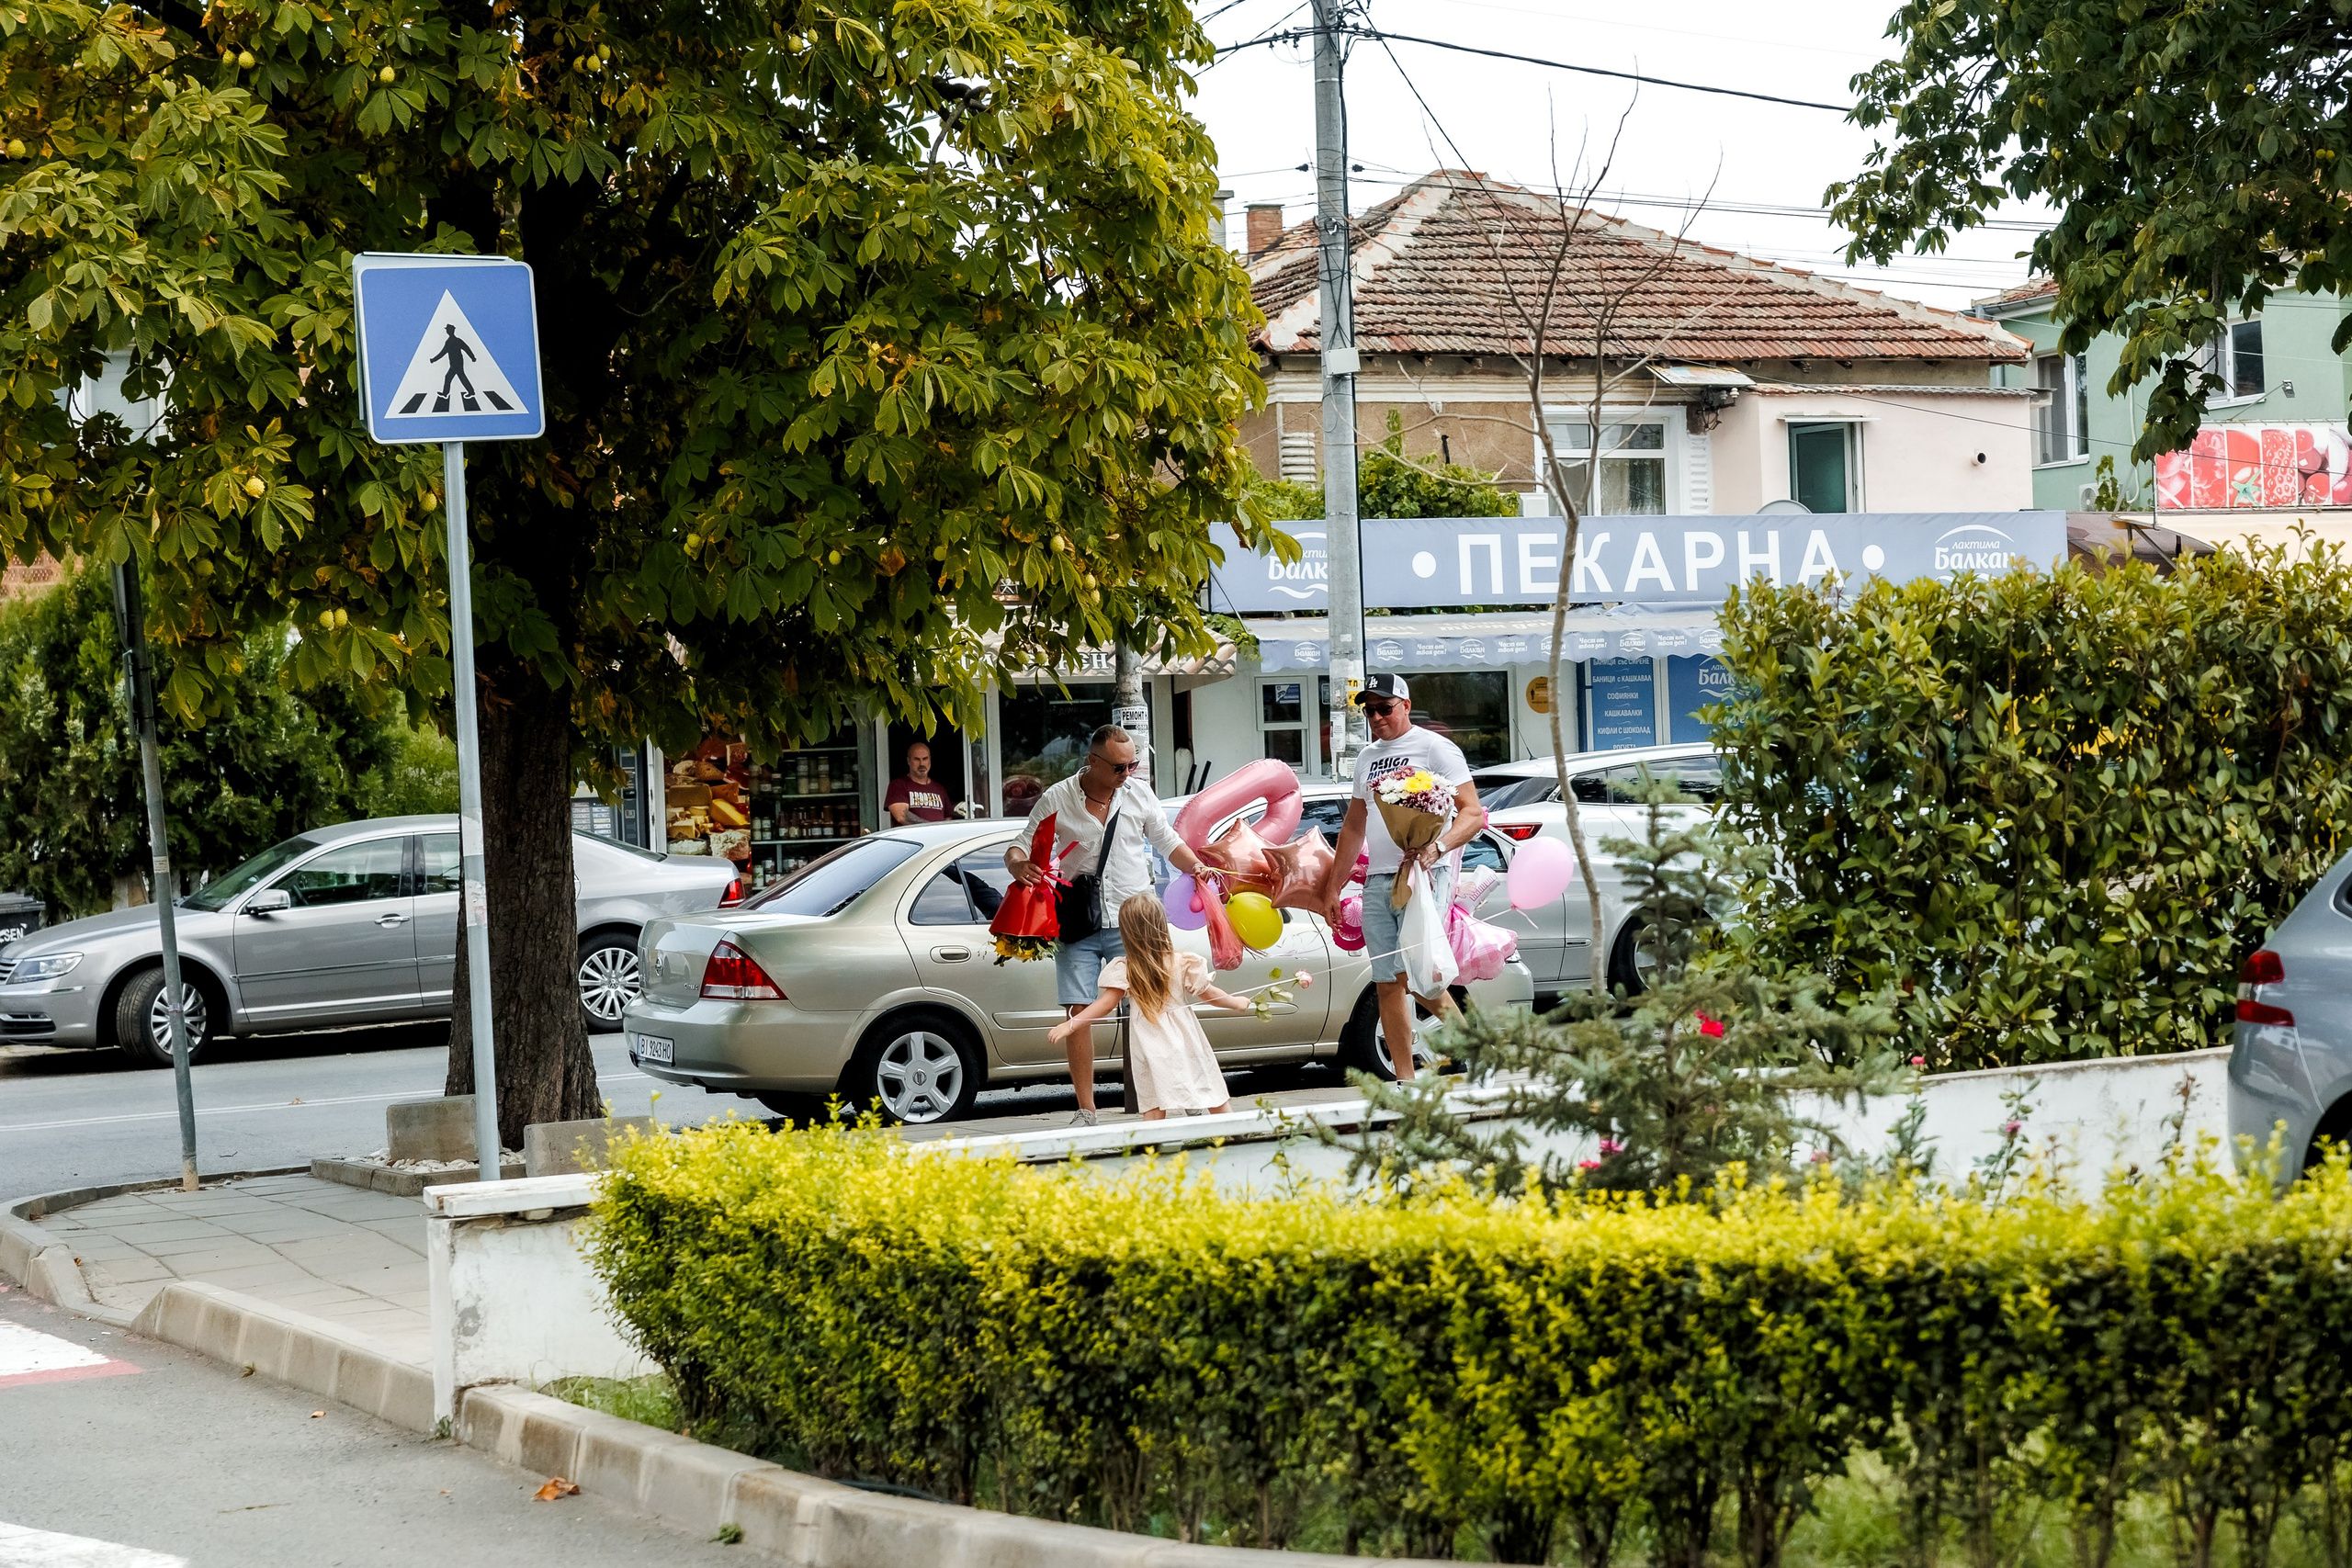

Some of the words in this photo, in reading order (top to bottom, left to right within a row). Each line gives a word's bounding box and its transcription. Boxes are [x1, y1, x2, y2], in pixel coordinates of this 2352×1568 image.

[1952, 540, 2001, 549] лактима
[1457, 529, 1848, 595] ПЕКАРНА
[1268, 555, 1329, 581] Балк
[1620, 639, 1645, 648] Балкан
[1295, 649, 1320, 657] Балкан
[1377, 648, 1403, 656] Балкан
[1460, 646, 1486, 654] Балкан
[1592, 675, 1616, 683] БАНИЦИ
[1622, 674, 1652, 682] КАШКАВАЛ
[1698, 668, 1736, 686] Балк
[1607, 692, 1639, 700] СОФИЯНКИ
[1123, 711, 1145, 721] РЕМОНТ
[1604, 709, 1643, 717] КАШКАВАЛКИ
[1597, 727, 1617, 735] КИФЛИ
[1623, 726, 1651, 735] ШОКОЛАД
